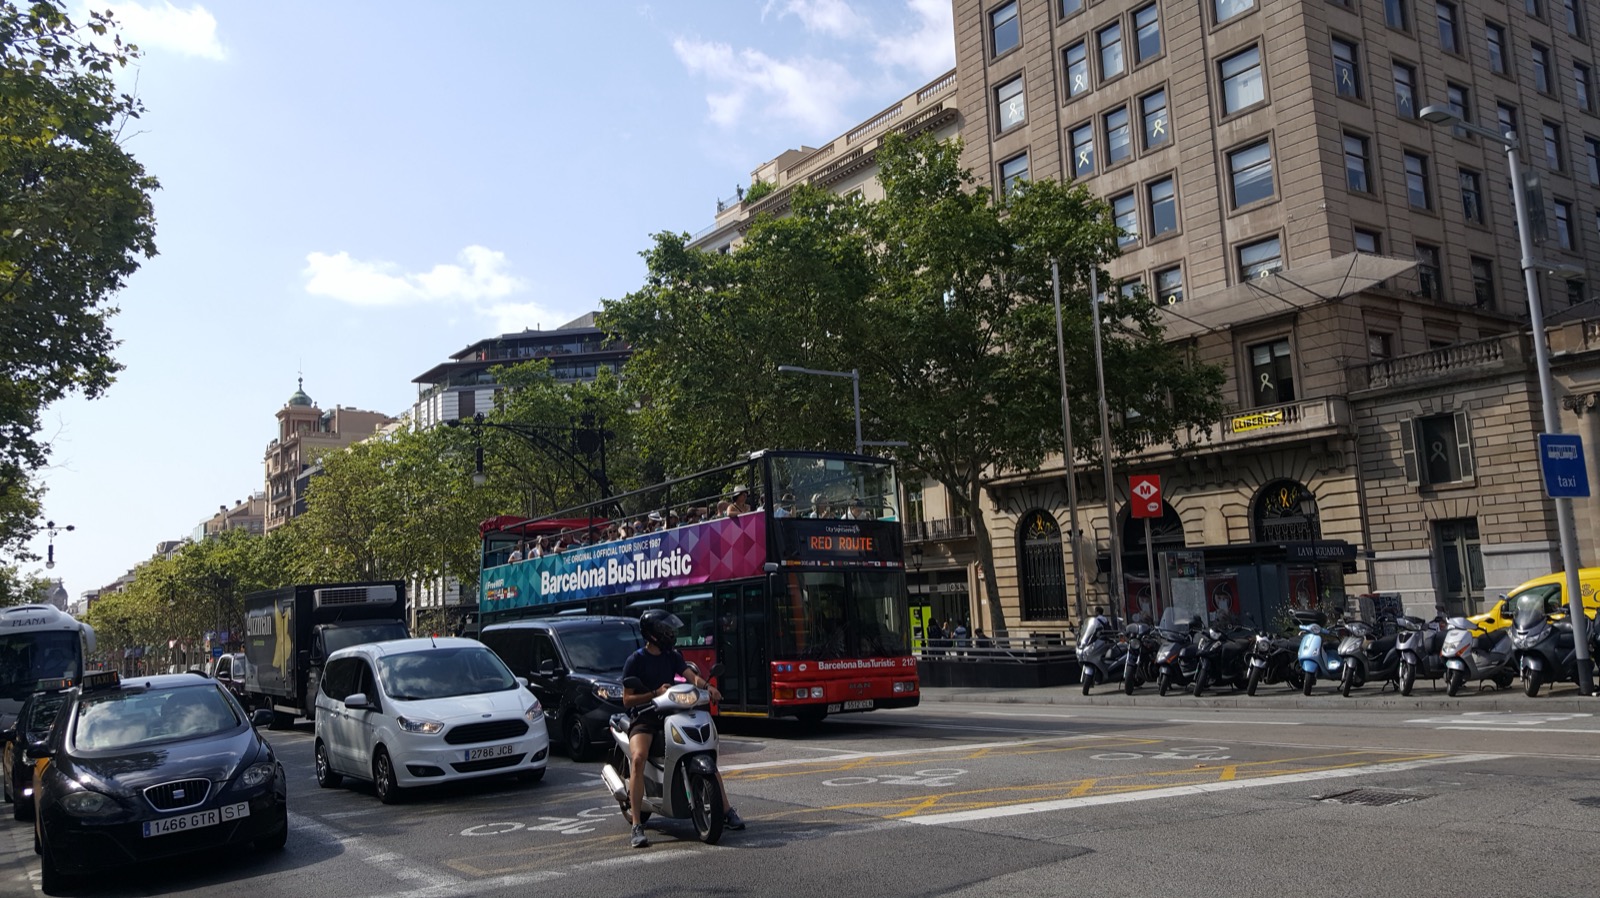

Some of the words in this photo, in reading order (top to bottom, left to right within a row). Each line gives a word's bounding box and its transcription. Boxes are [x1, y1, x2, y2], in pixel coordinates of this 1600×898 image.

[1557, 475, 1577, 488] taxi
[1140, 485, 1151, 495] M
[571, 552, 592, 563] ORIGINAL
[596, 547, 618, 559] OFFICIAL
[618, 543, 632, 554] TOUR
[633, 540, 648, 551] SINCE
[649, 537, 661, 548] 1987
[810, 536, 832, 550] RED
[839, 537, 873, 551] ROUTE
[541, 564, 606, 596] Barcelona
[12, 618, 46, 627] PLANA
[818, 660, 857, 671] Barcelona
[902, 658, 916, 667] 2127
[471, 748, 494, 760] 2786
[497, 744, 513, 756] JCB
[155, 817, 187, 834] 1466
[191, 811, 216, 827] GTR
[224, 803, 246, 819] SP
